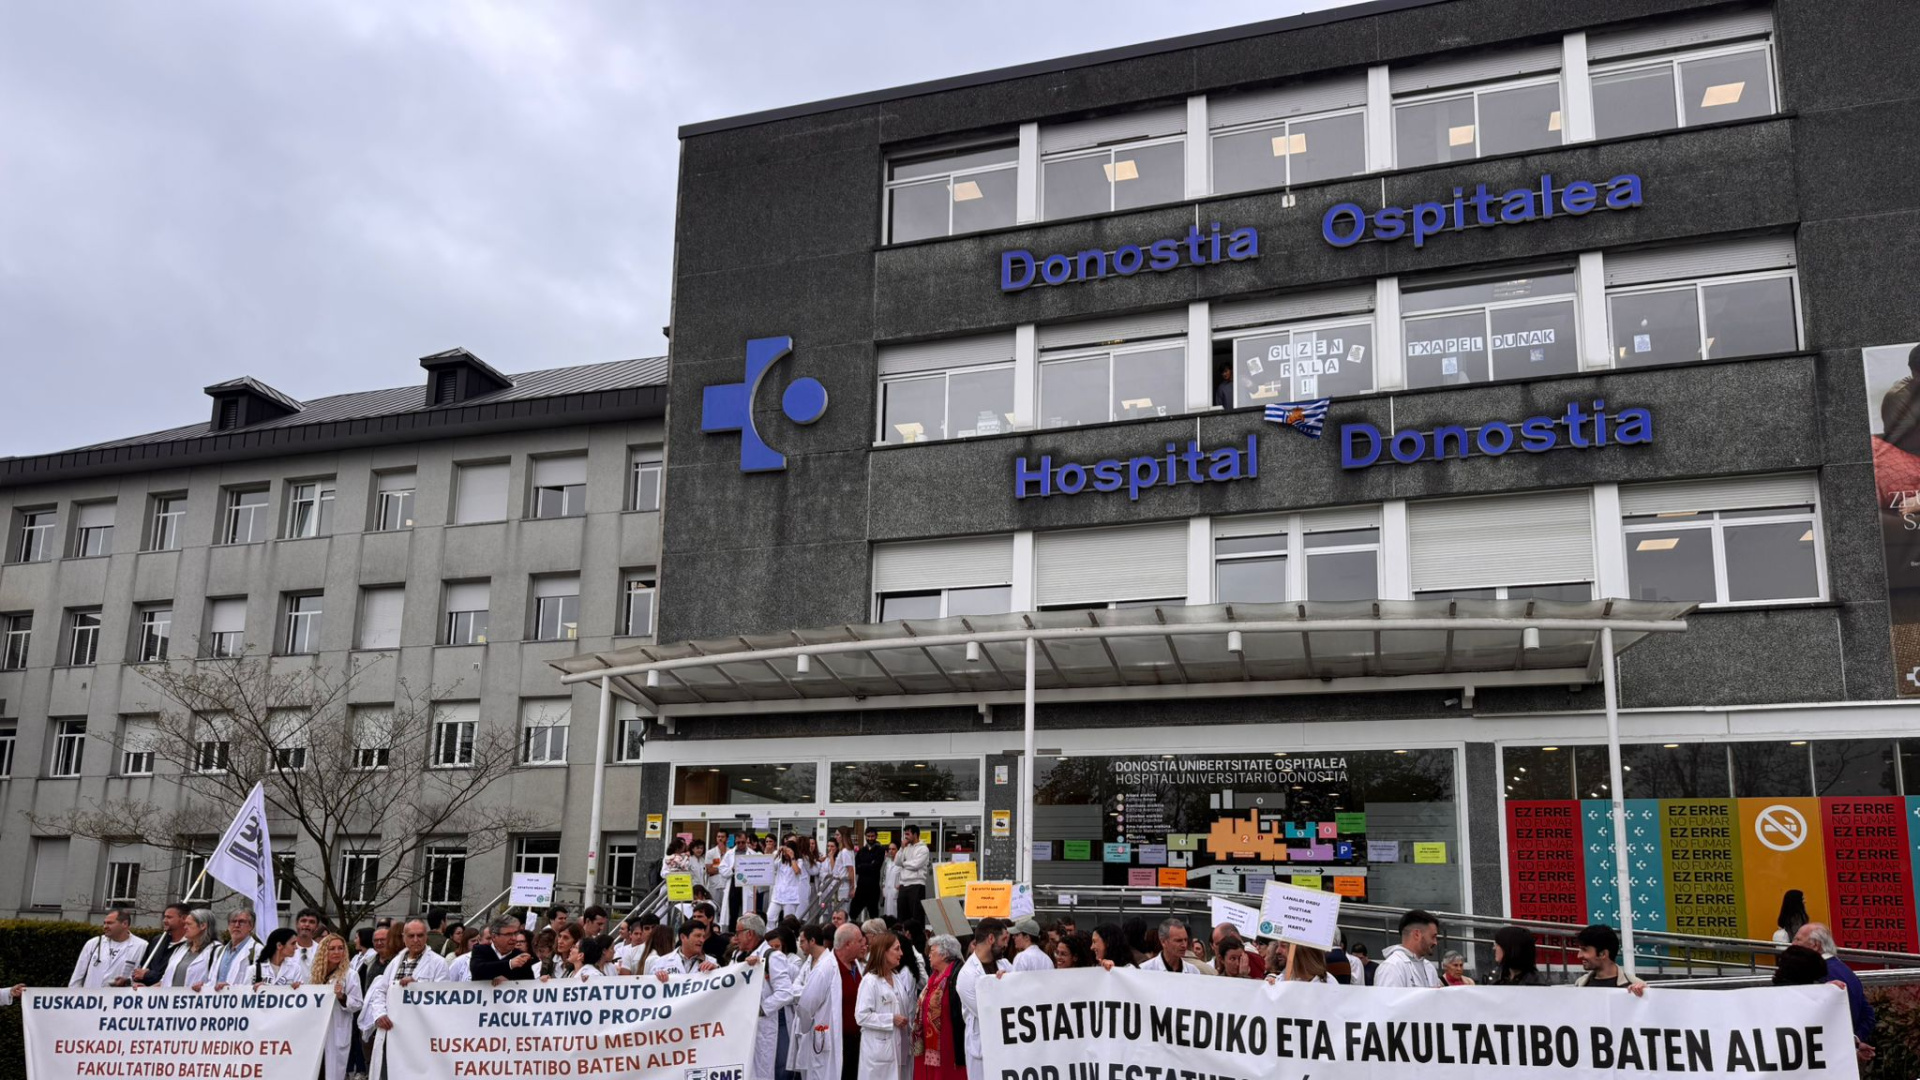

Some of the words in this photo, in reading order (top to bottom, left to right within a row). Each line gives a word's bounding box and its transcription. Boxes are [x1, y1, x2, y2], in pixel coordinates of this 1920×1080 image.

[1001, 222, 1260, 292] Donostia
[1322, 174, 1643, 248] Ospitalea
[1408, 338, 1483, 355] TXAPEL
[1492, 330, 1554, 348] DUNAK
[1015, 434, 1258, 500] Hospital
[1340, 399, 1654, 471] Donostia
[1115, 761, 1177, 772] DONOSTIA
[1178, 759, 1273, 772] UNIBERTSITATE
[1274, 757, 1348, 770] OSPITALEA
[1278, 771, 1349, 784] DONOSTIA
[1514, 807, 1532, 818] EZ
[1534, 807, 1572, 818] ERRE
[1668, 805, 1687, 816] EZ
[1689, 805, 1728, 816] ERRE
[1832, 804, 1851, 814] EZ
[1854, 804, 1896, 814] ERRE
[1514, 818, 1532, 828] NO
[1535, 818, 1573, 828] FUMAR
[1668, 816, 1686, 826] NO
[1689, 816, 1729, 826] FUMAR
[1832, 816, 1851, 826] NO
[1854, 816, 1897, 826] FUMAR
[1516, 828, 1534, 838] EZ
[1536, 828, 1573, 838] ERRE
[1670, 827, 1688, 838] EZ
[1691, 827, 1730, 838] ERRE
[1833, 826, 1853, 837] EZ
[1856, 826, 1898, 837] ERRE
[1516, 840, 1534, 849] NO
[1536, 840, 1574, 849] FUMAR
[1670, 839, 1688, 848] NO
[1691, 839, 1731, 848] FUMAR
[1833, 839, 1852, 848] NO
[1856, 839, 1898, 848] FUMAR
[1340, 846, 1348, 854] P
[1517, 850, 1534, 860] EZ
[1537, 850, 1574, 860] ERRE
[1672, 850, 1690, 860] EZ
[1693, 850, 1732, 860] ERRE
[1835, 849, 1855, 860] EZ
[1858, 849, 1899, 860] ERRE
[1518, 861, 1534, 870] NO
[1537, 861, 1575, 870] FUMAR
[1672, 861, 1690, 870] NO
[1692, 861, 1733, 870] FUMAR
[1836, 861, 1855, 871] NO
[1858, 861, 1901, 871] FUMAR
[1518, 872, 1536, 882] EZ
[1538, 872, 1575, 882] ERRE
[1673, 872, 1692, 882] EZ
[1694, 872, 1734, 882] ERRE
[1837, 872, 1857, 883] EZ
[1860, 872, 1902, 883] ERRE
[1518, 882, 1536, 892] NO
[1538, 882, 1576, 892] FUMAR
[1673, 883, 1691, 892] NO
[1694, 883, 1735, 892] FUMAR
[1838, 884, 1857, 894] NO
[1860, 884, 1904, 894] FUMAR
[1520, 893, 1537, 903] EZ
[1540, 893, 1577, 903] ERRE
[1675, 894, 1693, 904] EZ
[1696, 894, 1735, 904] ERRE
[1839, 895, 1860, 906] EZ
[1862, 895, 1905, 906] ERRE
[1520, 904, 1537, 914] NO
[1539, 904, 1578, 914] FUMAR
[1675, 905, 1693, 915] NO
[1696, 905, 1737, 915] FUMAR
[1840, 907, 1860, 917] NO
[1862, 907, 1906, 917] FUMAR
[1676, 916, 1695, 927] EZ
[1698, 916, 1737, 927] ERRE
[1842, 918, 1862, 930] EZ
[1864, 918, 1906, 930] ERRE
[1842, 930, 1861, 940] NO
[1864, 930, 1908, 940] FUMAR
[402, 988, 488, 1007] EUSKADI,
[492, 988, 528, 1004] POR
[532, 988, 558, 1004] UN
[562, 984, 657, 1004] ESTATUTO
[662, 978, 737, 1000] MÉDICO
[740, 970, 754, 986] Y
[32, 995, 108, 1012] EUSKADI,
[112, 995, 142, 1010] POR
[146, 995, 168, 1009] UN
[172, 994, 238, 1010] ESTATUTO
[242, 990, 308, 1009] MÉDICO
[312, 993, 326, 1008] Y
[478, 1009, 594, 1028] FACULTATIVO
[598, 1005, 673, 1025] PROPIO
[98, 1016, 196, 1032] FACULTATIVO
[200, 1016, 250, 1032] PROPIO
[430, 1036, 512, 1055] EUSKADI,
[514, 1034, 599, 1053] ESTATUTU
[604, 1026, 684, 1051] MEDIKO
[688, 1021, 726, 1041] ETA
[1000, 1000, 1143, 1046] ESTATUTU
[1150, 1004, 1269, 1056] MEDIKO
[1275, 1016, 1337, 1061] ETA
[1344, 1021, 1580, 1068] FAKULTATIBO
[1588, 1026, 1715, 1073] BATEN
[1726, 1025, 1828, 1073] ALDE
[54, 1040, 126, 1056] EUSKADI,
[130, 1040, 198, 1055] ESTATUTU
[201, 1040, 254, 1056] MEDIKO
[259, 1040, 292, 1056] ETA
[453, 1058, 572, 1076] FAKULTATIBO
[576, 1054, 642, 1075] BATEN
[646, 1048, 698, 1069] ALDE
[76, 1061, 174, 1077] FAKULTATIBO
[178, 1062, 221, 1078] BATEN
[223, 1063, 264, 1079] ALDE
